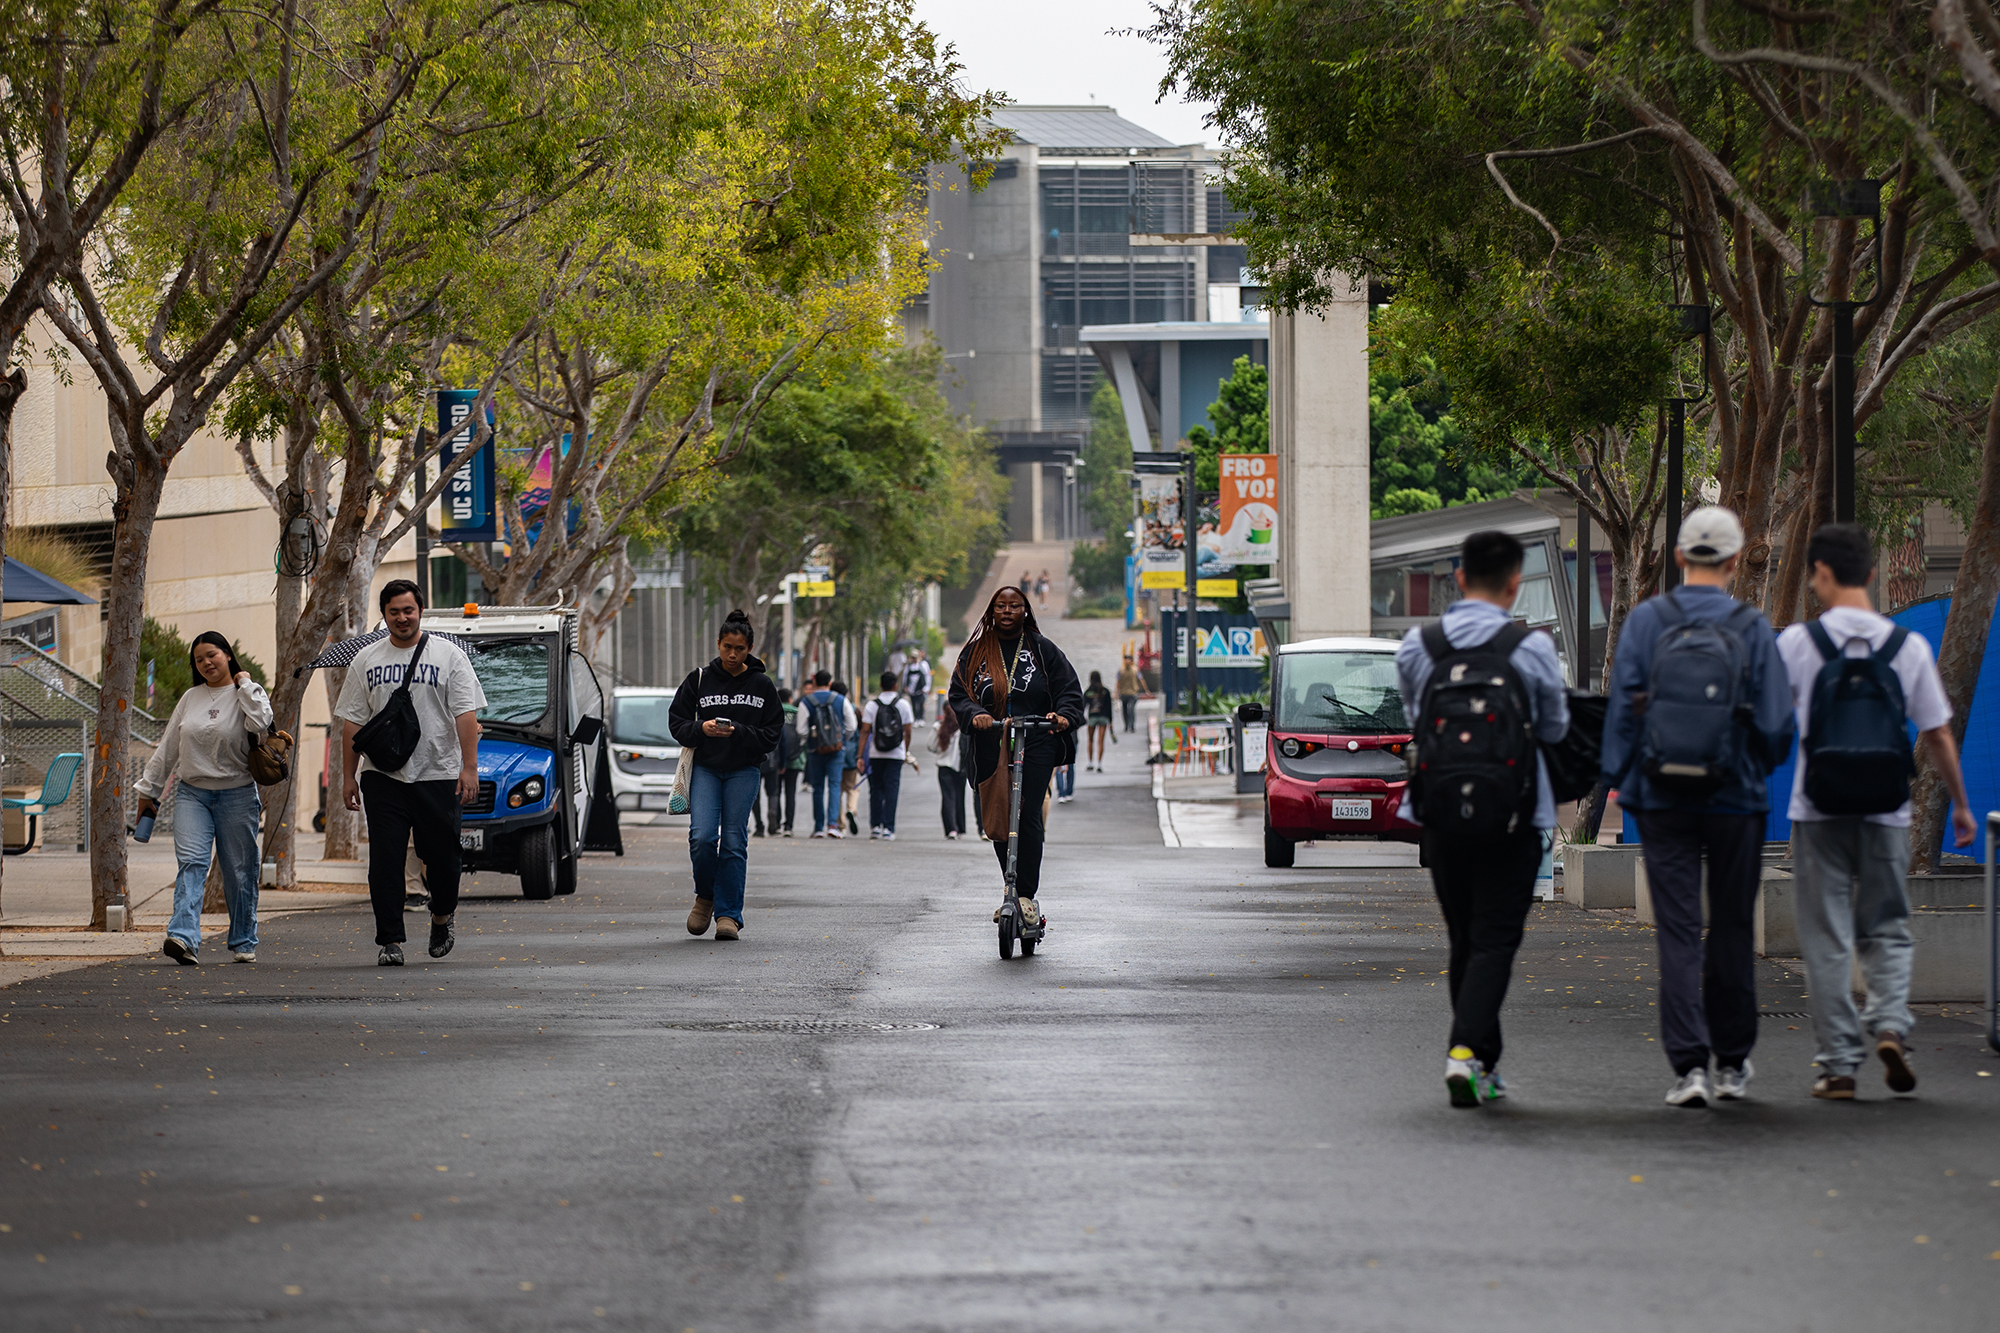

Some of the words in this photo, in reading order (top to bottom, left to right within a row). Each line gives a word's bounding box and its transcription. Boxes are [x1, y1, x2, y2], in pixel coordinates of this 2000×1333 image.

[1222, 458, 1266, 477] FRO
[1235, 478, 1275, 499] YO!
[453, 497, 472, 520] UC
[700, 695, 729, 708] SKRS
[730, 694, 765, 708] JEANS
[1335, 807, 1369, 817] 1431598
